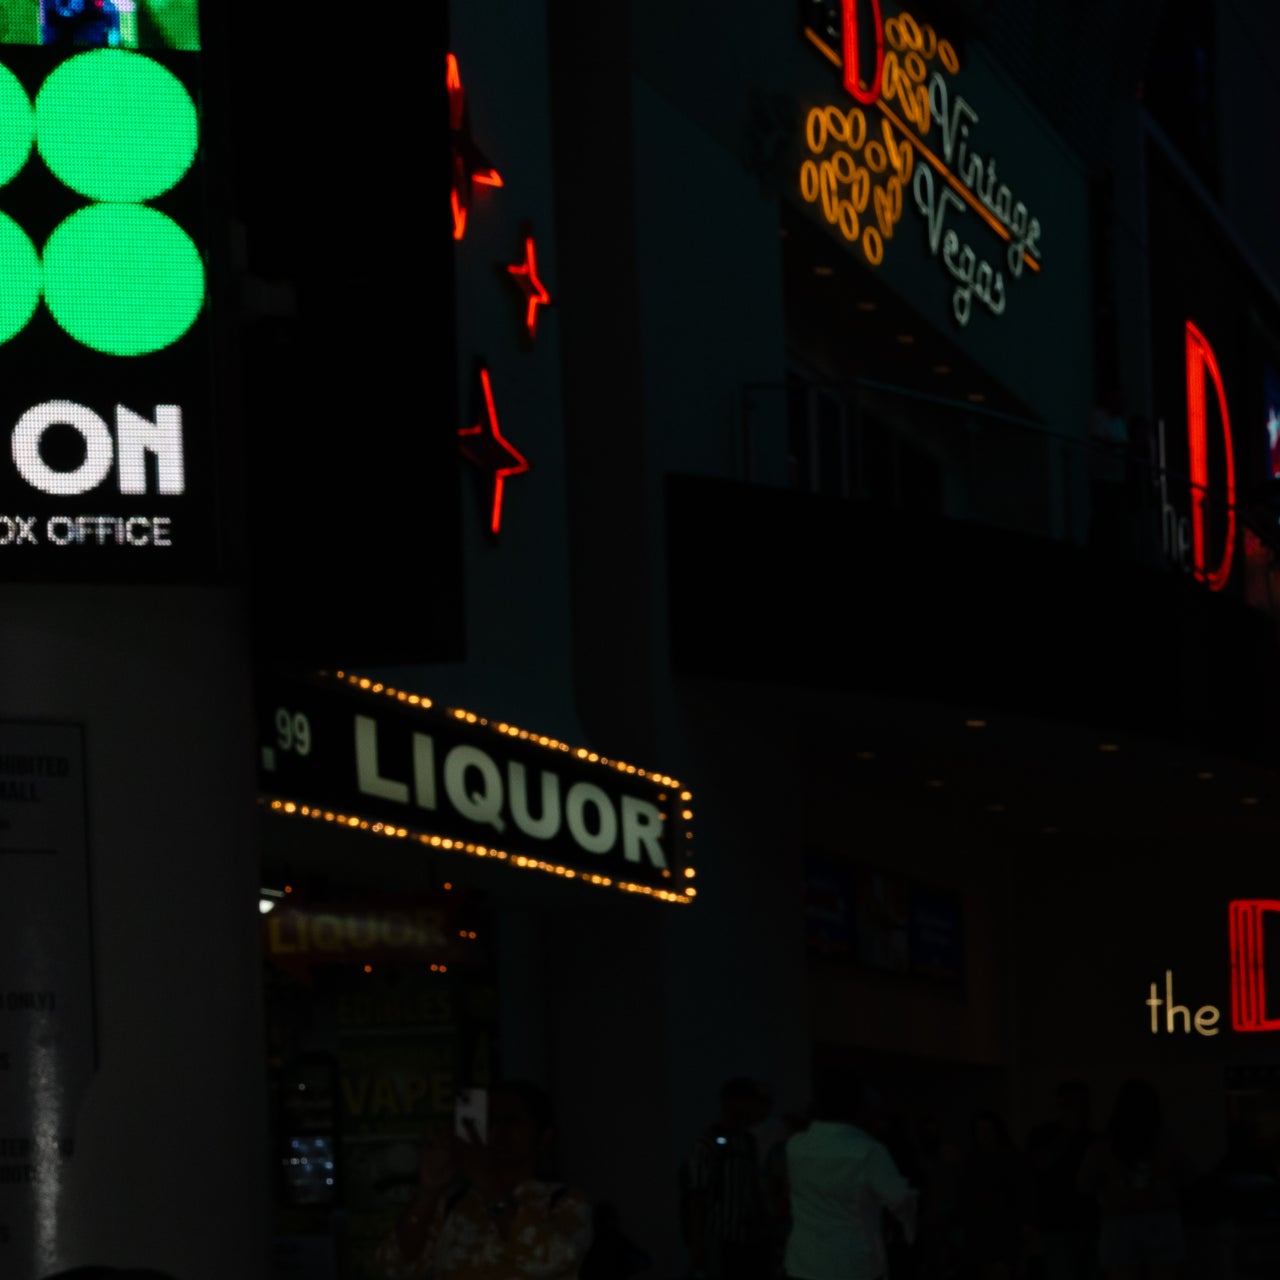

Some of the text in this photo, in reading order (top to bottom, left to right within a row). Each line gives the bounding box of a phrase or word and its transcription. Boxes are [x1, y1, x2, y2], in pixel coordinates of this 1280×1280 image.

[928, 71, 1041, 277] Vintage
[913, 162, 1006, 325] Vegas
[11, 398, 186, 496] ON
[47, 516, 172, 547] OFFICE
[353, 712, 669, 870] LIQUOR
[1145, 967, 1221, 1037] the
